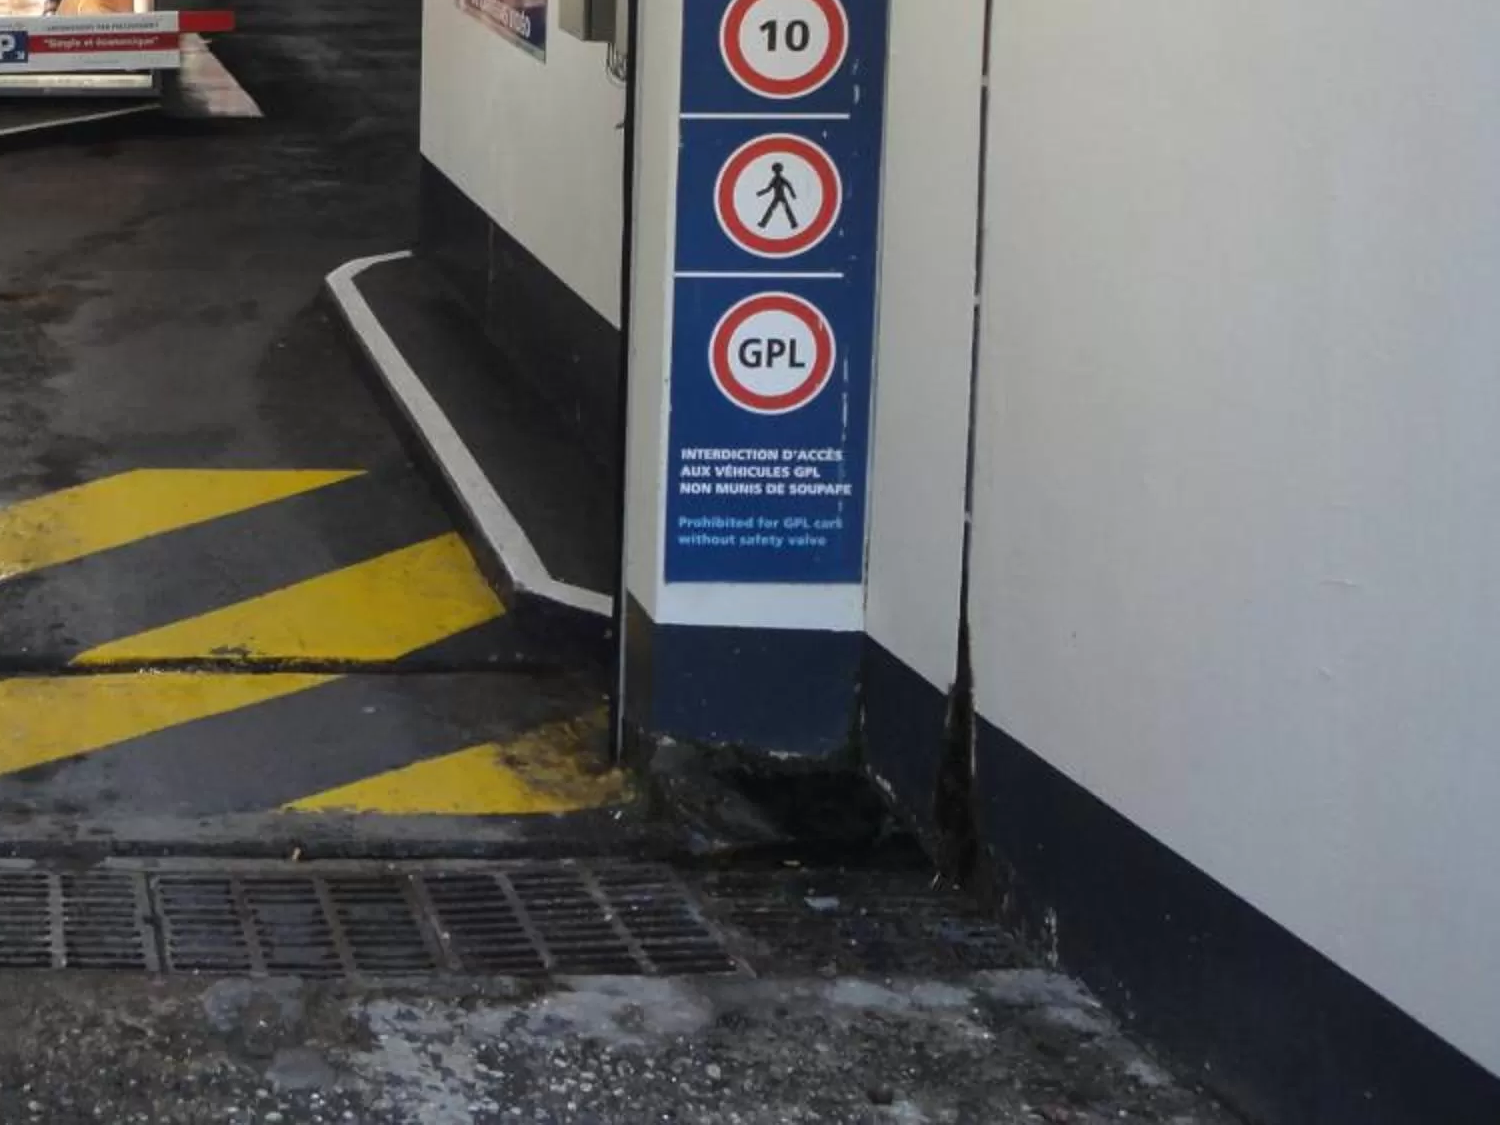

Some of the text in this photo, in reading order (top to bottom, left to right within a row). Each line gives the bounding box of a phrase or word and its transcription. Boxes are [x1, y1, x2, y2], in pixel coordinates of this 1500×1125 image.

[759, 18, 811, 53] 10
[737, 338, 806, 369] GPL
[681, 448, 779, 461] INTERDICTION
[681, 464, 821, 479] AUX VÉHICULES GPL
[680, 483, 852, 496] NON MUNIS DE SOUPAPE
[678, 516, 754, 529] Prohibited
[757, 517, 779, 529] for
[783, 517, 810, 530] GPL
[678, 533, 827, 548] without safety valve
